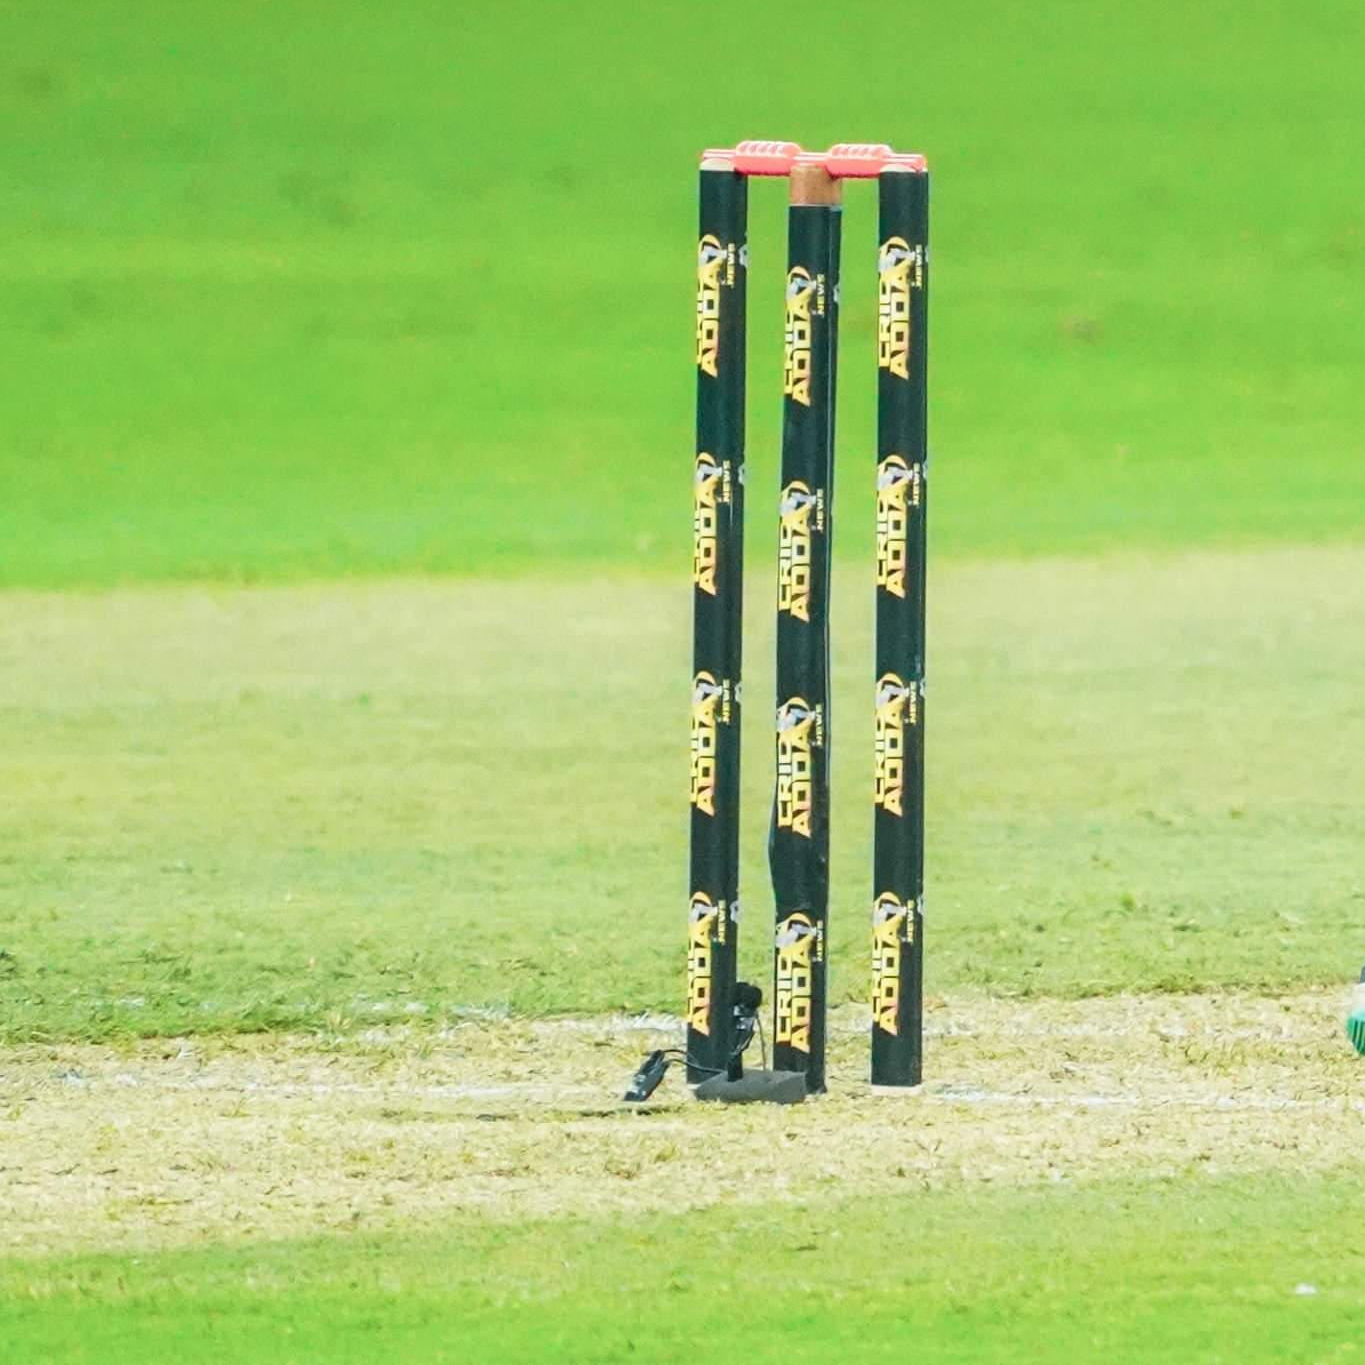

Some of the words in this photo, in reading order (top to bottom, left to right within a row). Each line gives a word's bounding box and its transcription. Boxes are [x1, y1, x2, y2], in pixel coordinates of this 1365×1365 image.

[701, 259, 720, 378] ADDA
[792, 286, 811, 407] ADDA
[890, 259, 909, 380] ADDA
[700, 475, 716, 595] ADDA
[791, 502, 810, 622] ADDA
[887, 478, 906, 598] ADDA
[697, 696, 715, 816] ADDA
[792, 720, 811, 838] ADDA
[884, 697, 903, 816] ADDA
[692, 916, 711, 1036] ADDA
[791, 934, 811, 1053] ADDA
[880, 918, 899, 1035] ADDA
